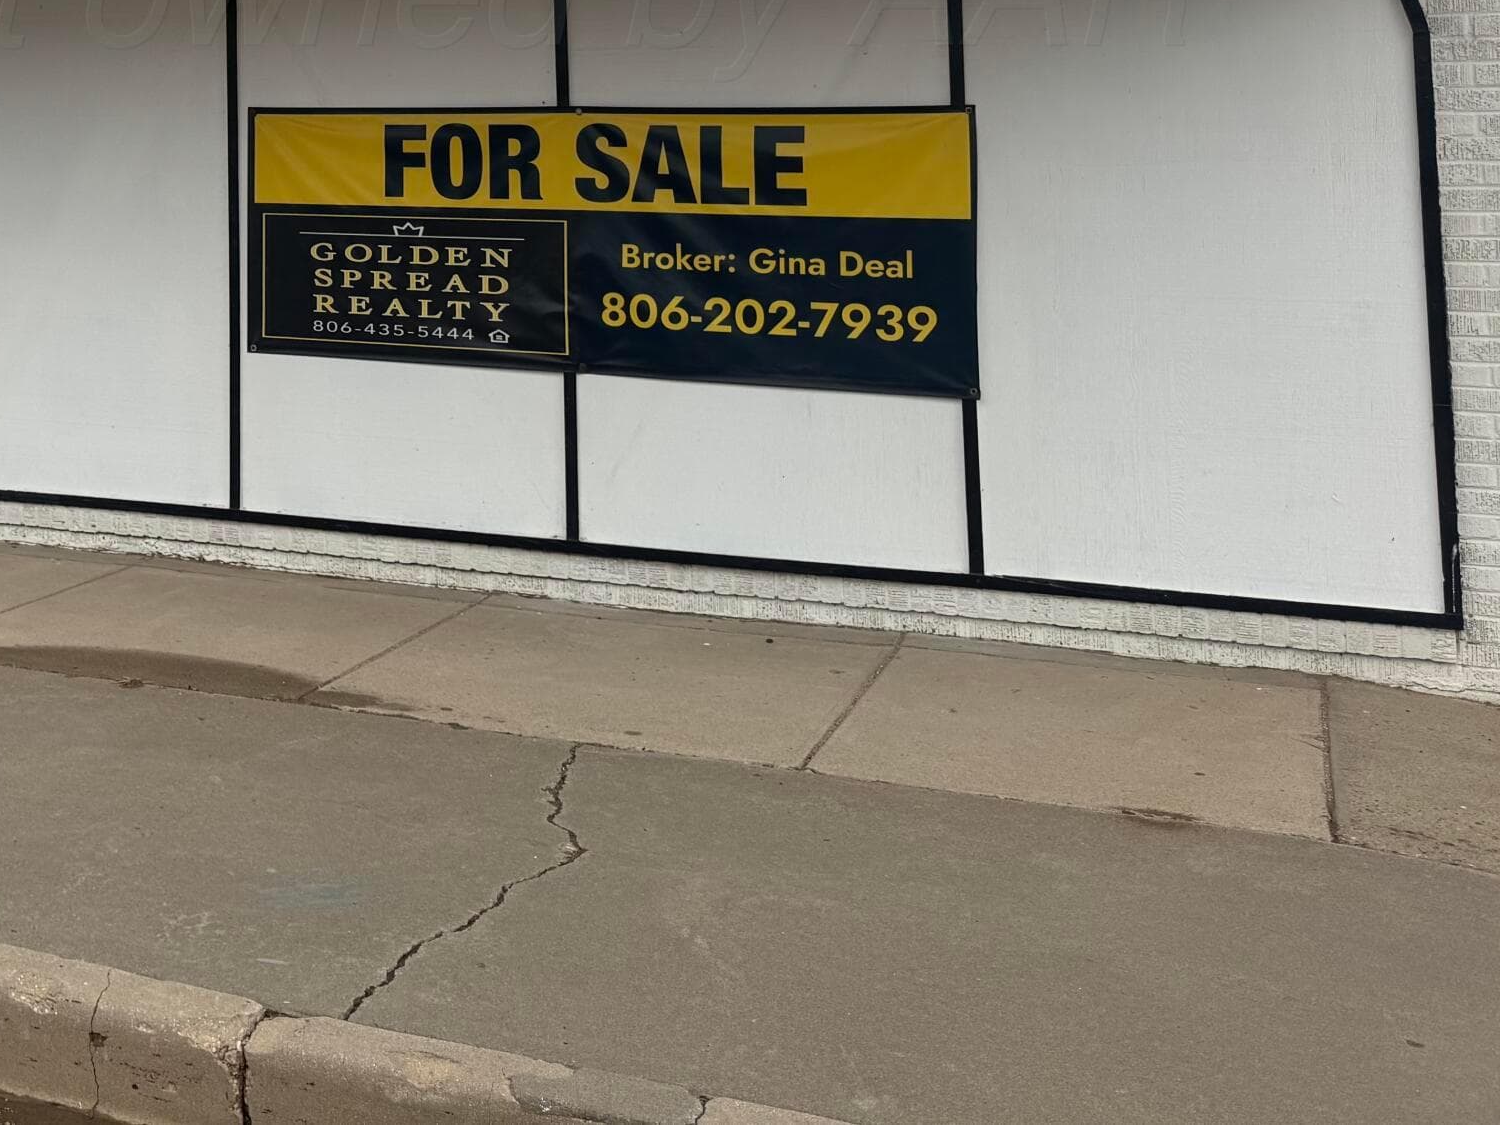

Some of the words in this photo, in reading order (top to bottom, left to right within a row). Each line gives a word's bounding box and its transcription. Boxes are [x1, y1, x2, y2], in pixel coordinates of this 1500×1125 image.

[383, 123, 543, 201] FOR
[573, 124, 808, 207] SALE
[310, 242, 513, 268] GOLDEN
[620, 243, 737, 275] Broker:
[748, 248, 827, 278] Gina
[838, 250, 914, 280] Deal
[313, 268, 510, 295] SPREAD
[312, 293, 510, 322] REALTY
[600, 292, 938, 343] 806-202-7939
[312, 320, 475, 341] 806-435-5444
